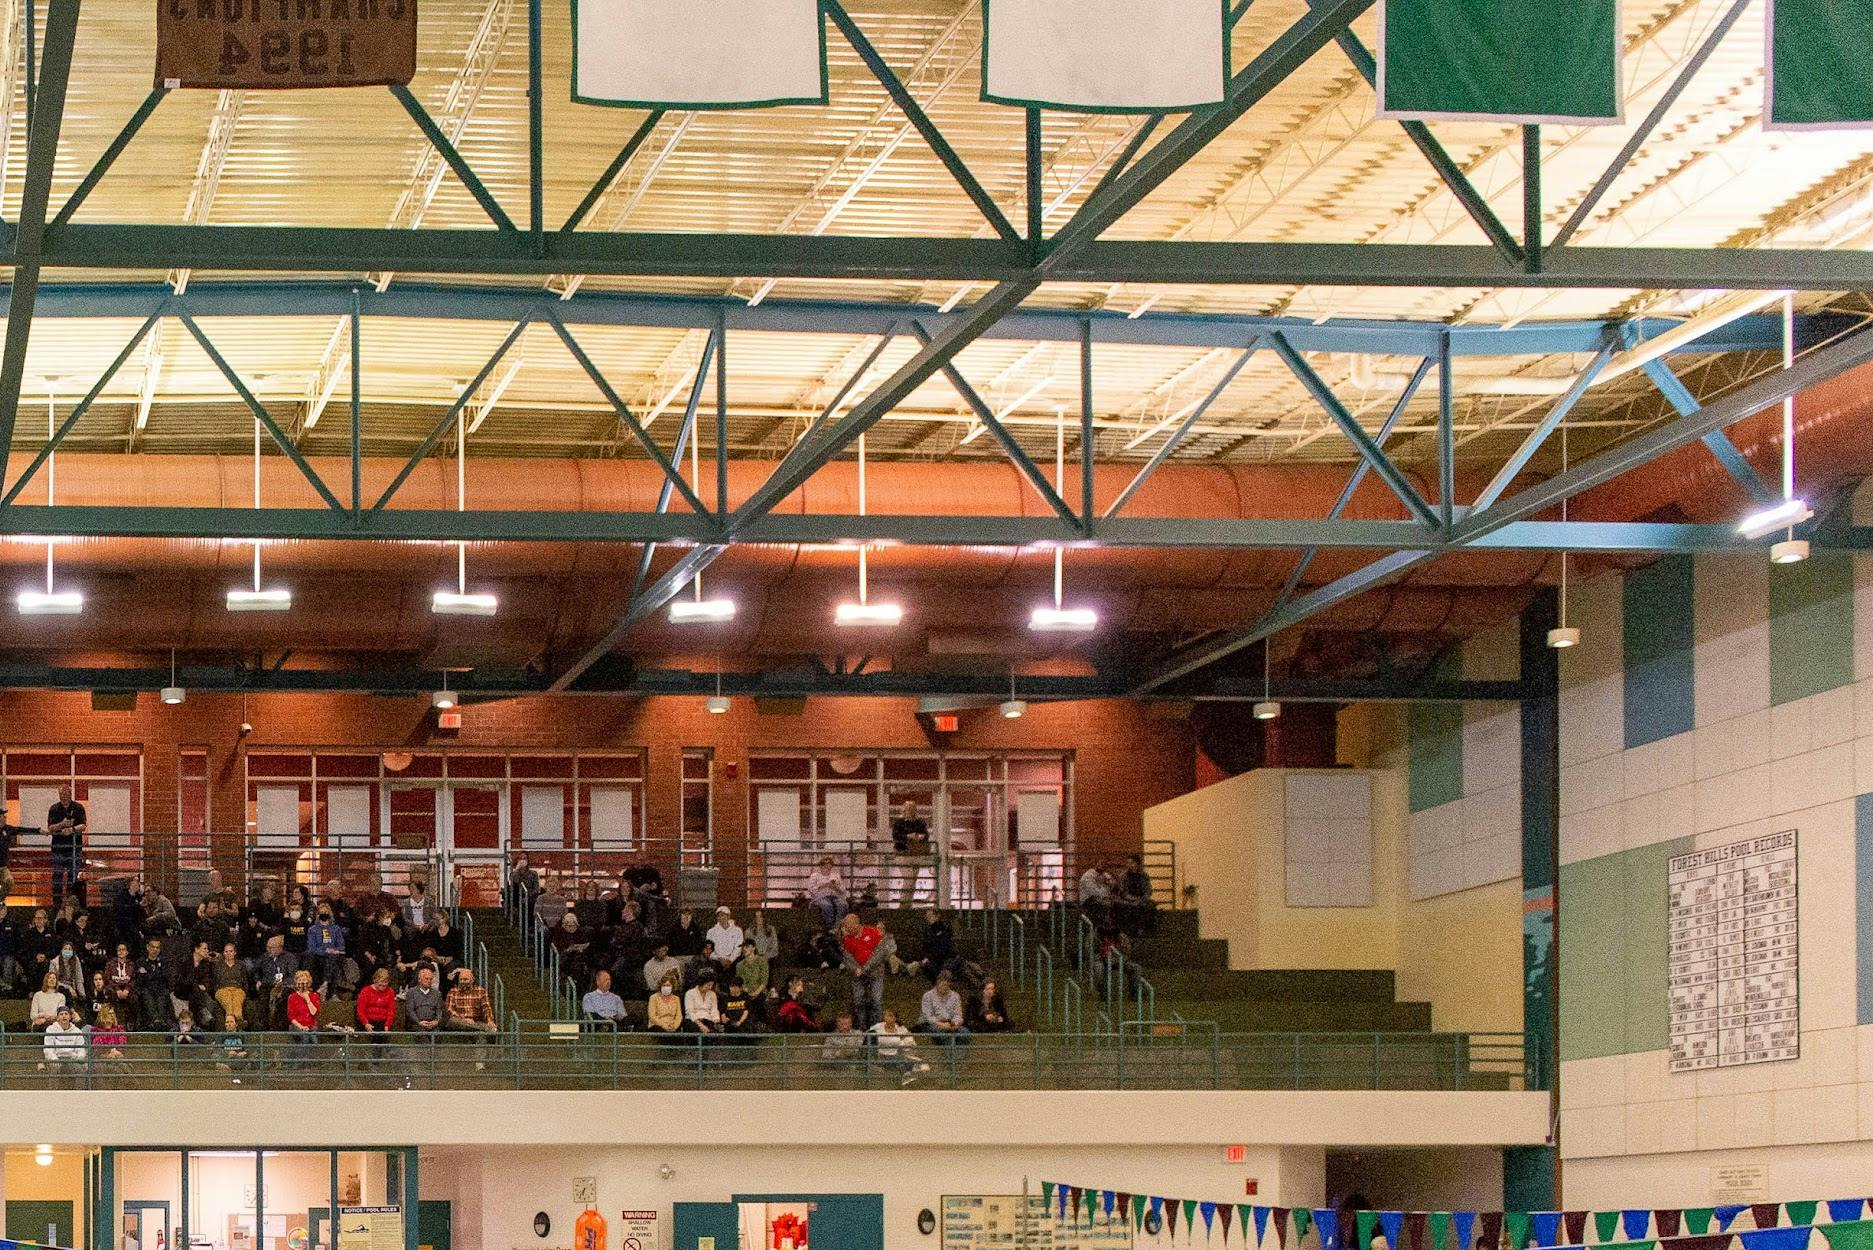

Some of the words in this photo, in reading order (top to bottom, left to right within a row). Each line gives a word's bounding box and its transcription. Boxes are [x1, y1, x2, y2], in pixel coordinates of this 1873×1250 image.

[1671, 853, 1703, 872] FOREST
[1705, 847, 1728, 863] HILLS
[1731, 842, 1752, 858] POOL
[1754, 832, 1793, 853] RECORDS
[624, 1211, 656, 1219] WARNING
